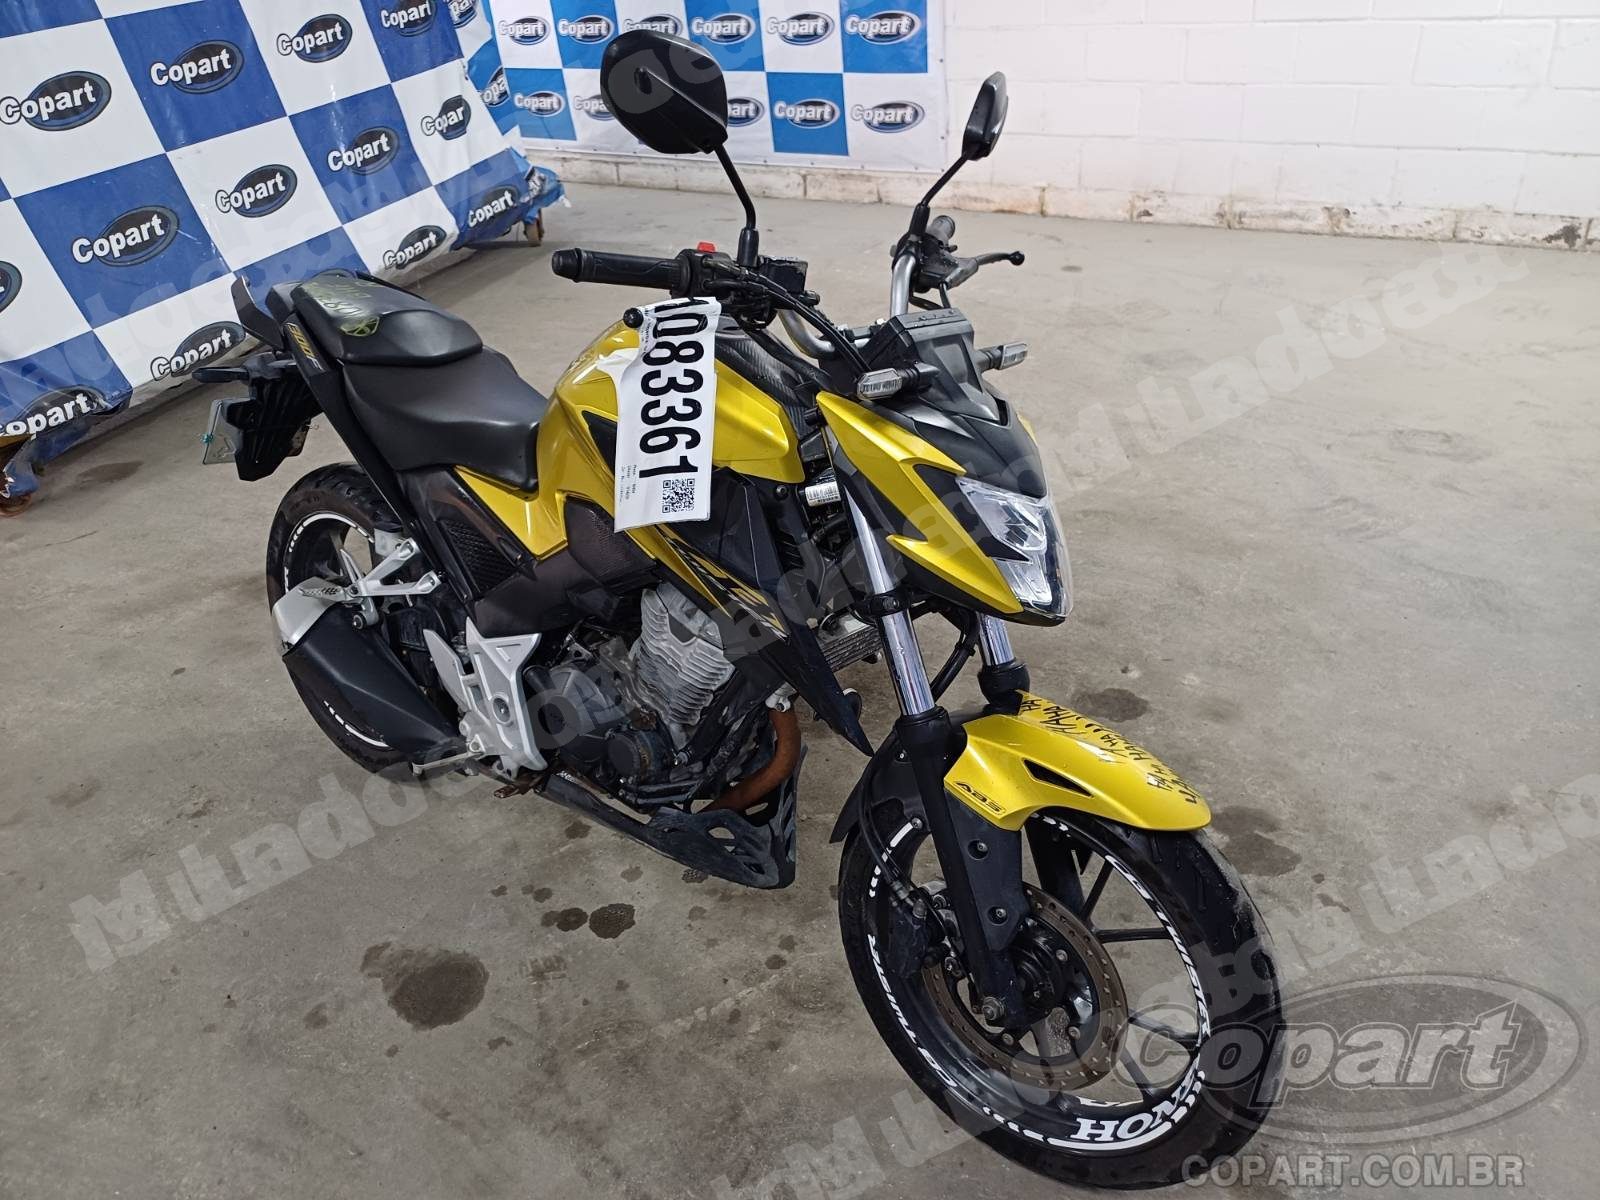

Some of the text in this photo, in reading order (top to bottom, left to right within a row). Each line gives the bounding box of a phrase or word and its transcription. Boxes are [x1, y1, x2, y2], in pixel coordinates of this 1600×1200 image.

[277, 21, 345, 55] Copart
[500, 19, 544, 37] Copart
[558, 18, 607, 39] Copart
[691, 16, 748, 39] Copart
[766, 15, 825, 38] Copart
[845, 14, 910, 39] Copart
[150, 48, 232, 86] Copart
[0, 79, 97, 122] Copart
[513, 91, 553, 111] Copart
[774, 100, 833, 122] Copart
[851, 103, 915, 124] Copart
[327, 133, 391, 172] Copart
[215, 171, 287, 213] Copart
[469, 190, 514, 228] Copart
[72, 214, 165, 264] Copart
[383, 230, 438, 270] Copart
[150, 328, 233, 382] Copart
[639, 297, 711, 478] 1083361
[0, 393, 91, 441] opart
